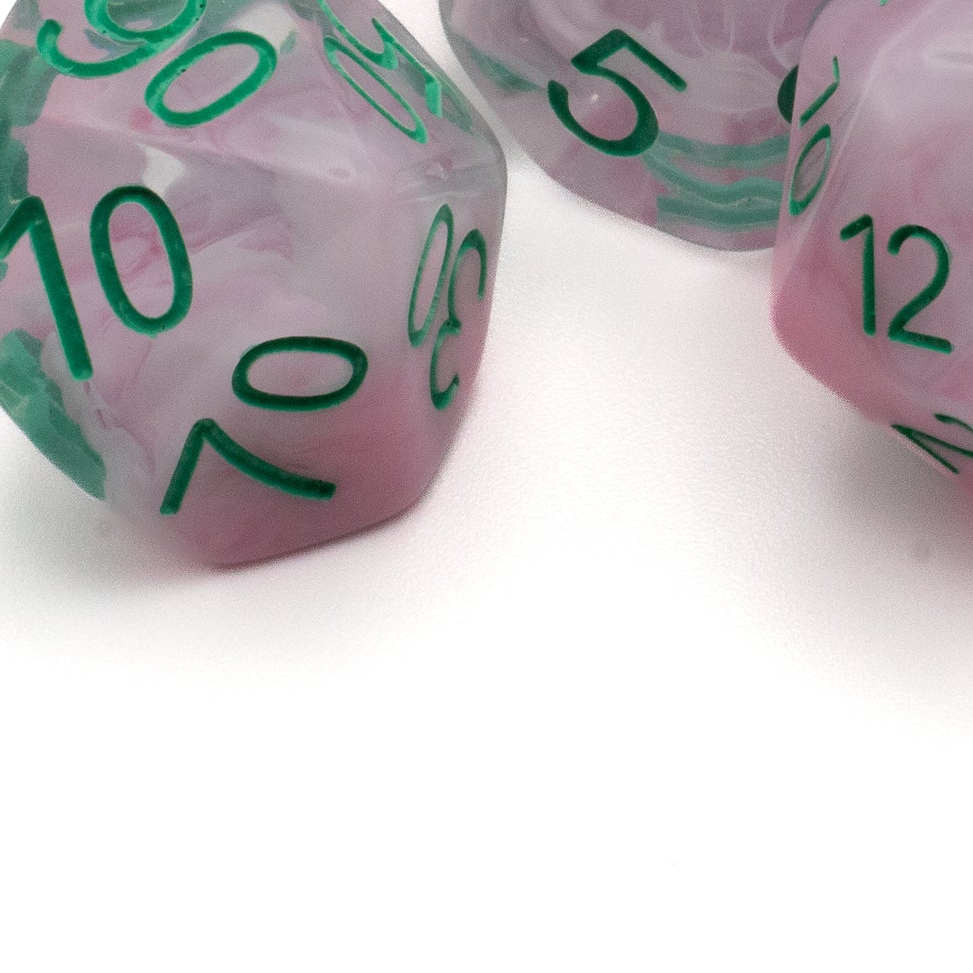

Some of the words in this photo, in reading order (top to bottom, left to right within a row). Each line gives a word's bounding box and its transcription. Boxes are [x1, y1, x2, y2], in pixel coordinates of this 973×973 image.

[547, 28, 687, 158] 5
[788, 55, 841, 217] 10
[0, 185, 194, 382] 10
[407, 204, 488, 411] 30
[839, 214, 954, 355] 12
[159, 336, 368, 516] 70
